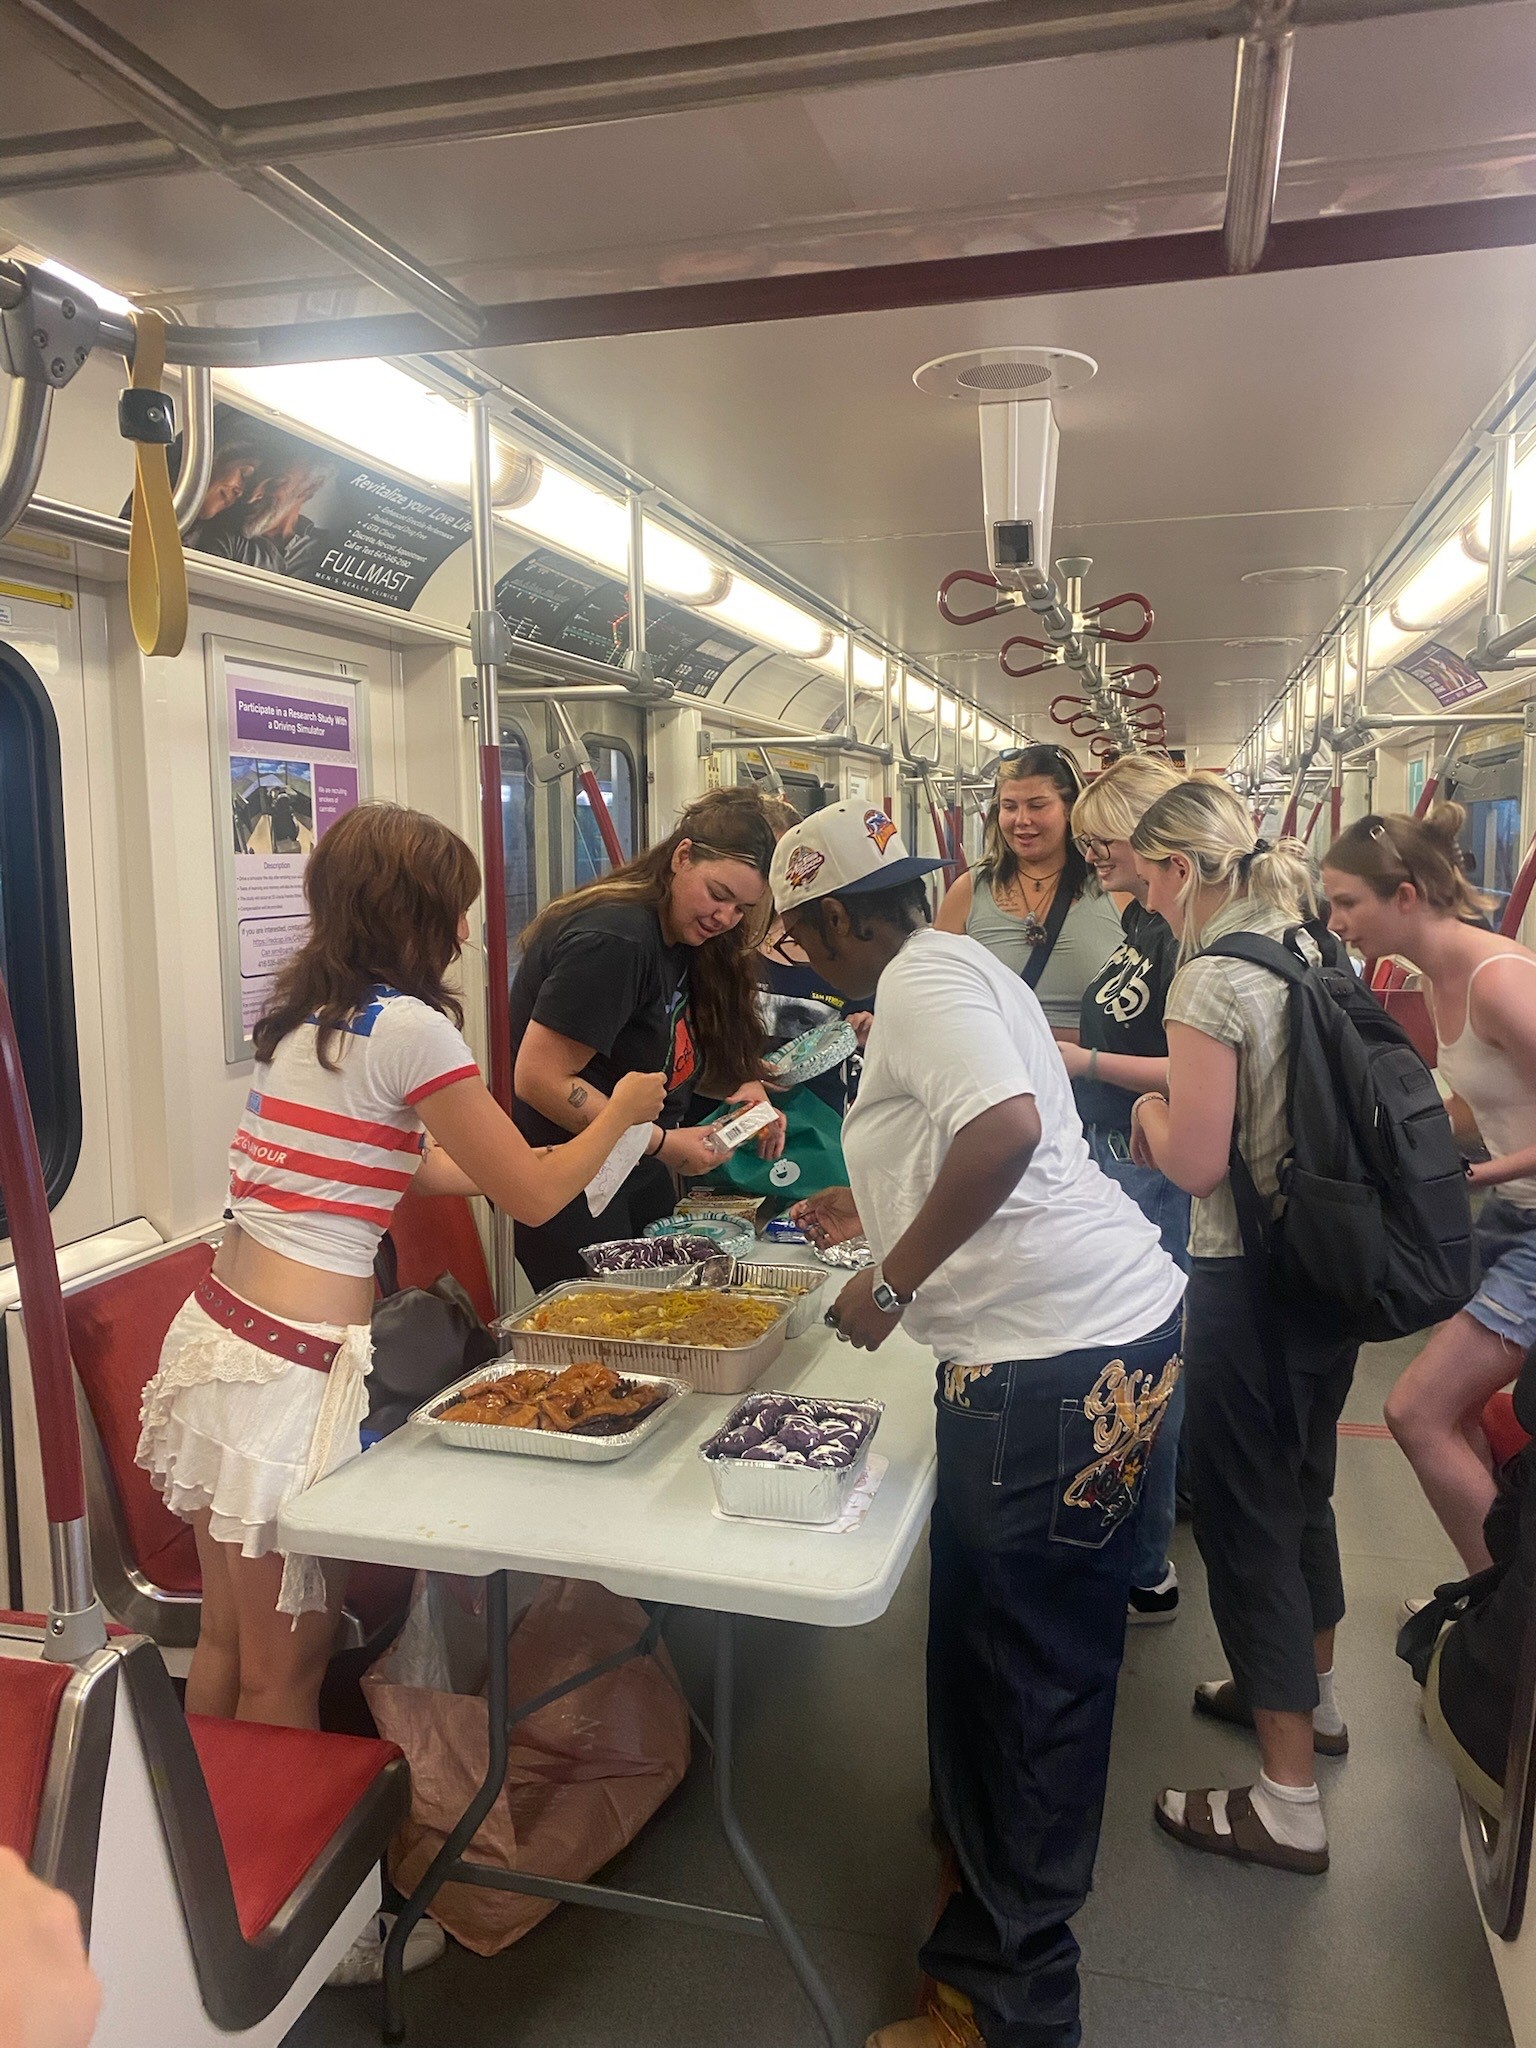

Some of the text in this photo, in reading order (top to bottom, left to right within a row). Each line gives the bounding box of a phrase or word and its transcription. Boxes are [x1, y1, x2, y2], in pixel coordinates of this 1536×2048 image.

[350, 474, 472, 532] Revitalize your Love Life
[367, 524, 379, 532] GTA
[344, 539, 355, 549] Call
[360, 547, 375, 556] Text
[321, 550, 414, 592] FULLMAST
[315, 572, 398, 601] MEN'S HEALTH CLINICS
[238, 700, 347, 726] Participate in a Research Study With
[268, 719, 325, 736] a Driving Simulator
[264, 862, 290, 871] Description
